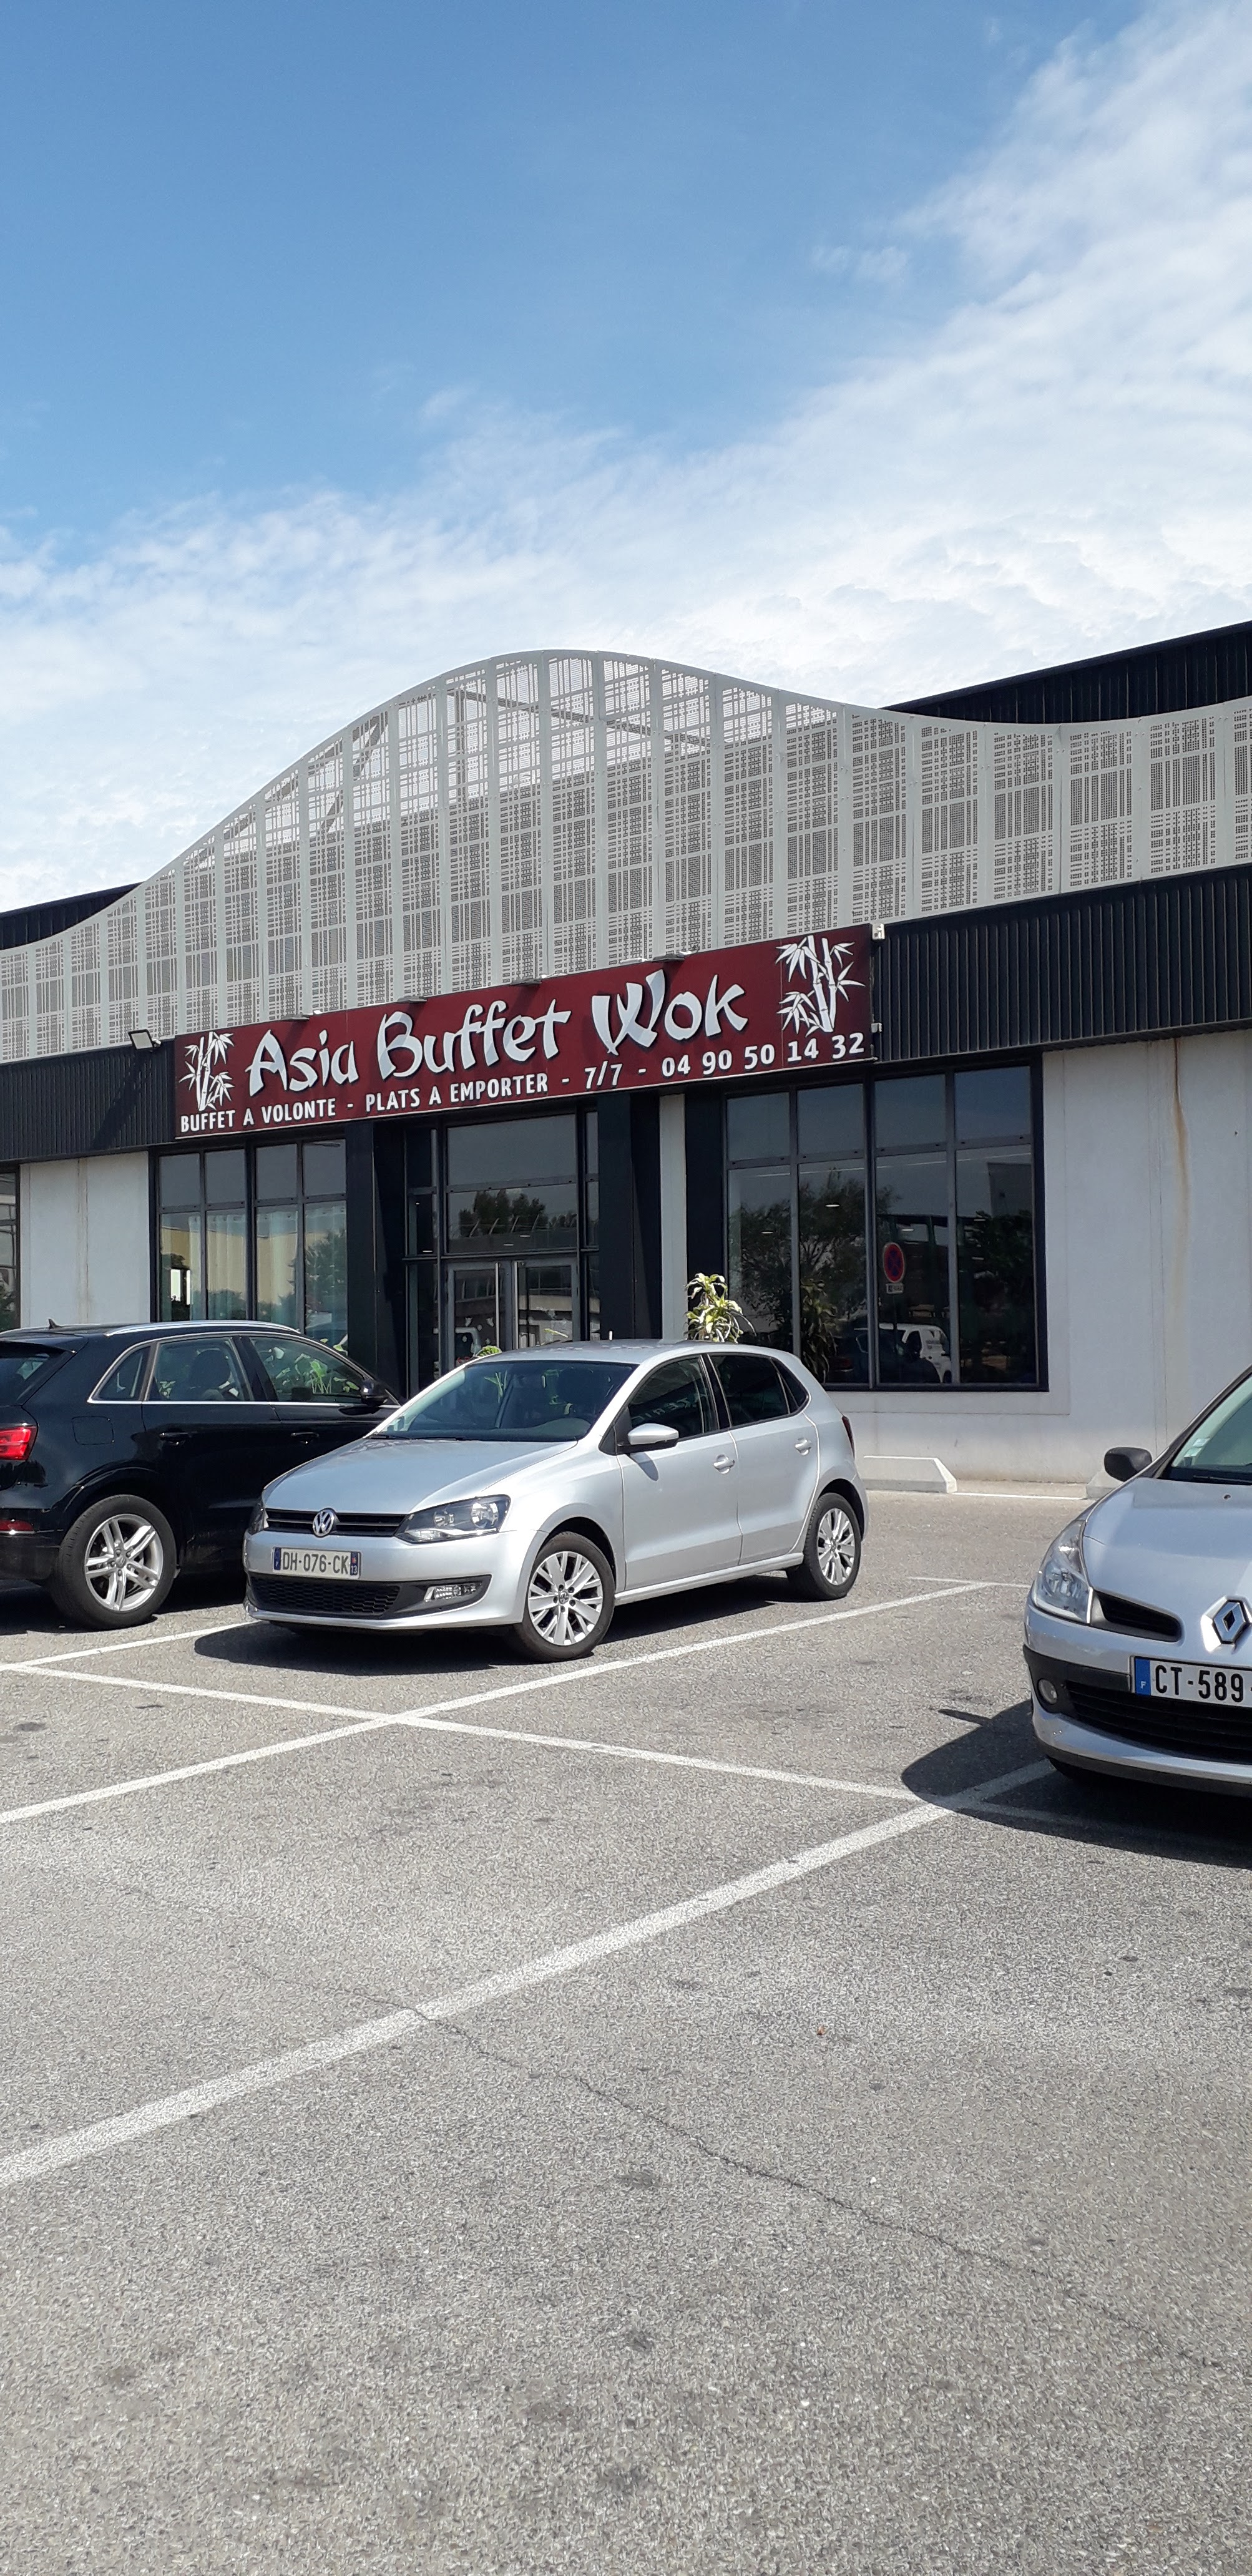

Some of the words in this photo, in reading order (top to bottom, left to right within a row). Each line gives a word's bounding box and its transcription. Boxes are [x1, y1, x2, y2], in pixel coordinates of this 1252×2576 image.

[180, 1110, 235, 1133] BUFFET
[243, 1108, 255, 1126] A
[262, 1098, 336, 1124] VOLONTE
[366, 1088, 420, 1112] PLATS
[429, 1086, 442, 1105] A
[450, 1073, 548, 1103] EMPORTER
[585, 1060, 622, 1090] 7/7
[662, 1055, 691, 1077] 04
[702, 1050, 732, 1075] 90
[745, 1044, 775, 1070] 50
[788, 1038, 819, 1062] 14
[832, 1032, 864, 1059] 32
[245, 1029, 359, 1096] Asia
[378, 998, 571, 1080] Buffet
[591, 970, 748, 1055] Wok
[283, 1551, 349, 1574] DH-076-CK
[351, 1565, 358, 1574] 13
